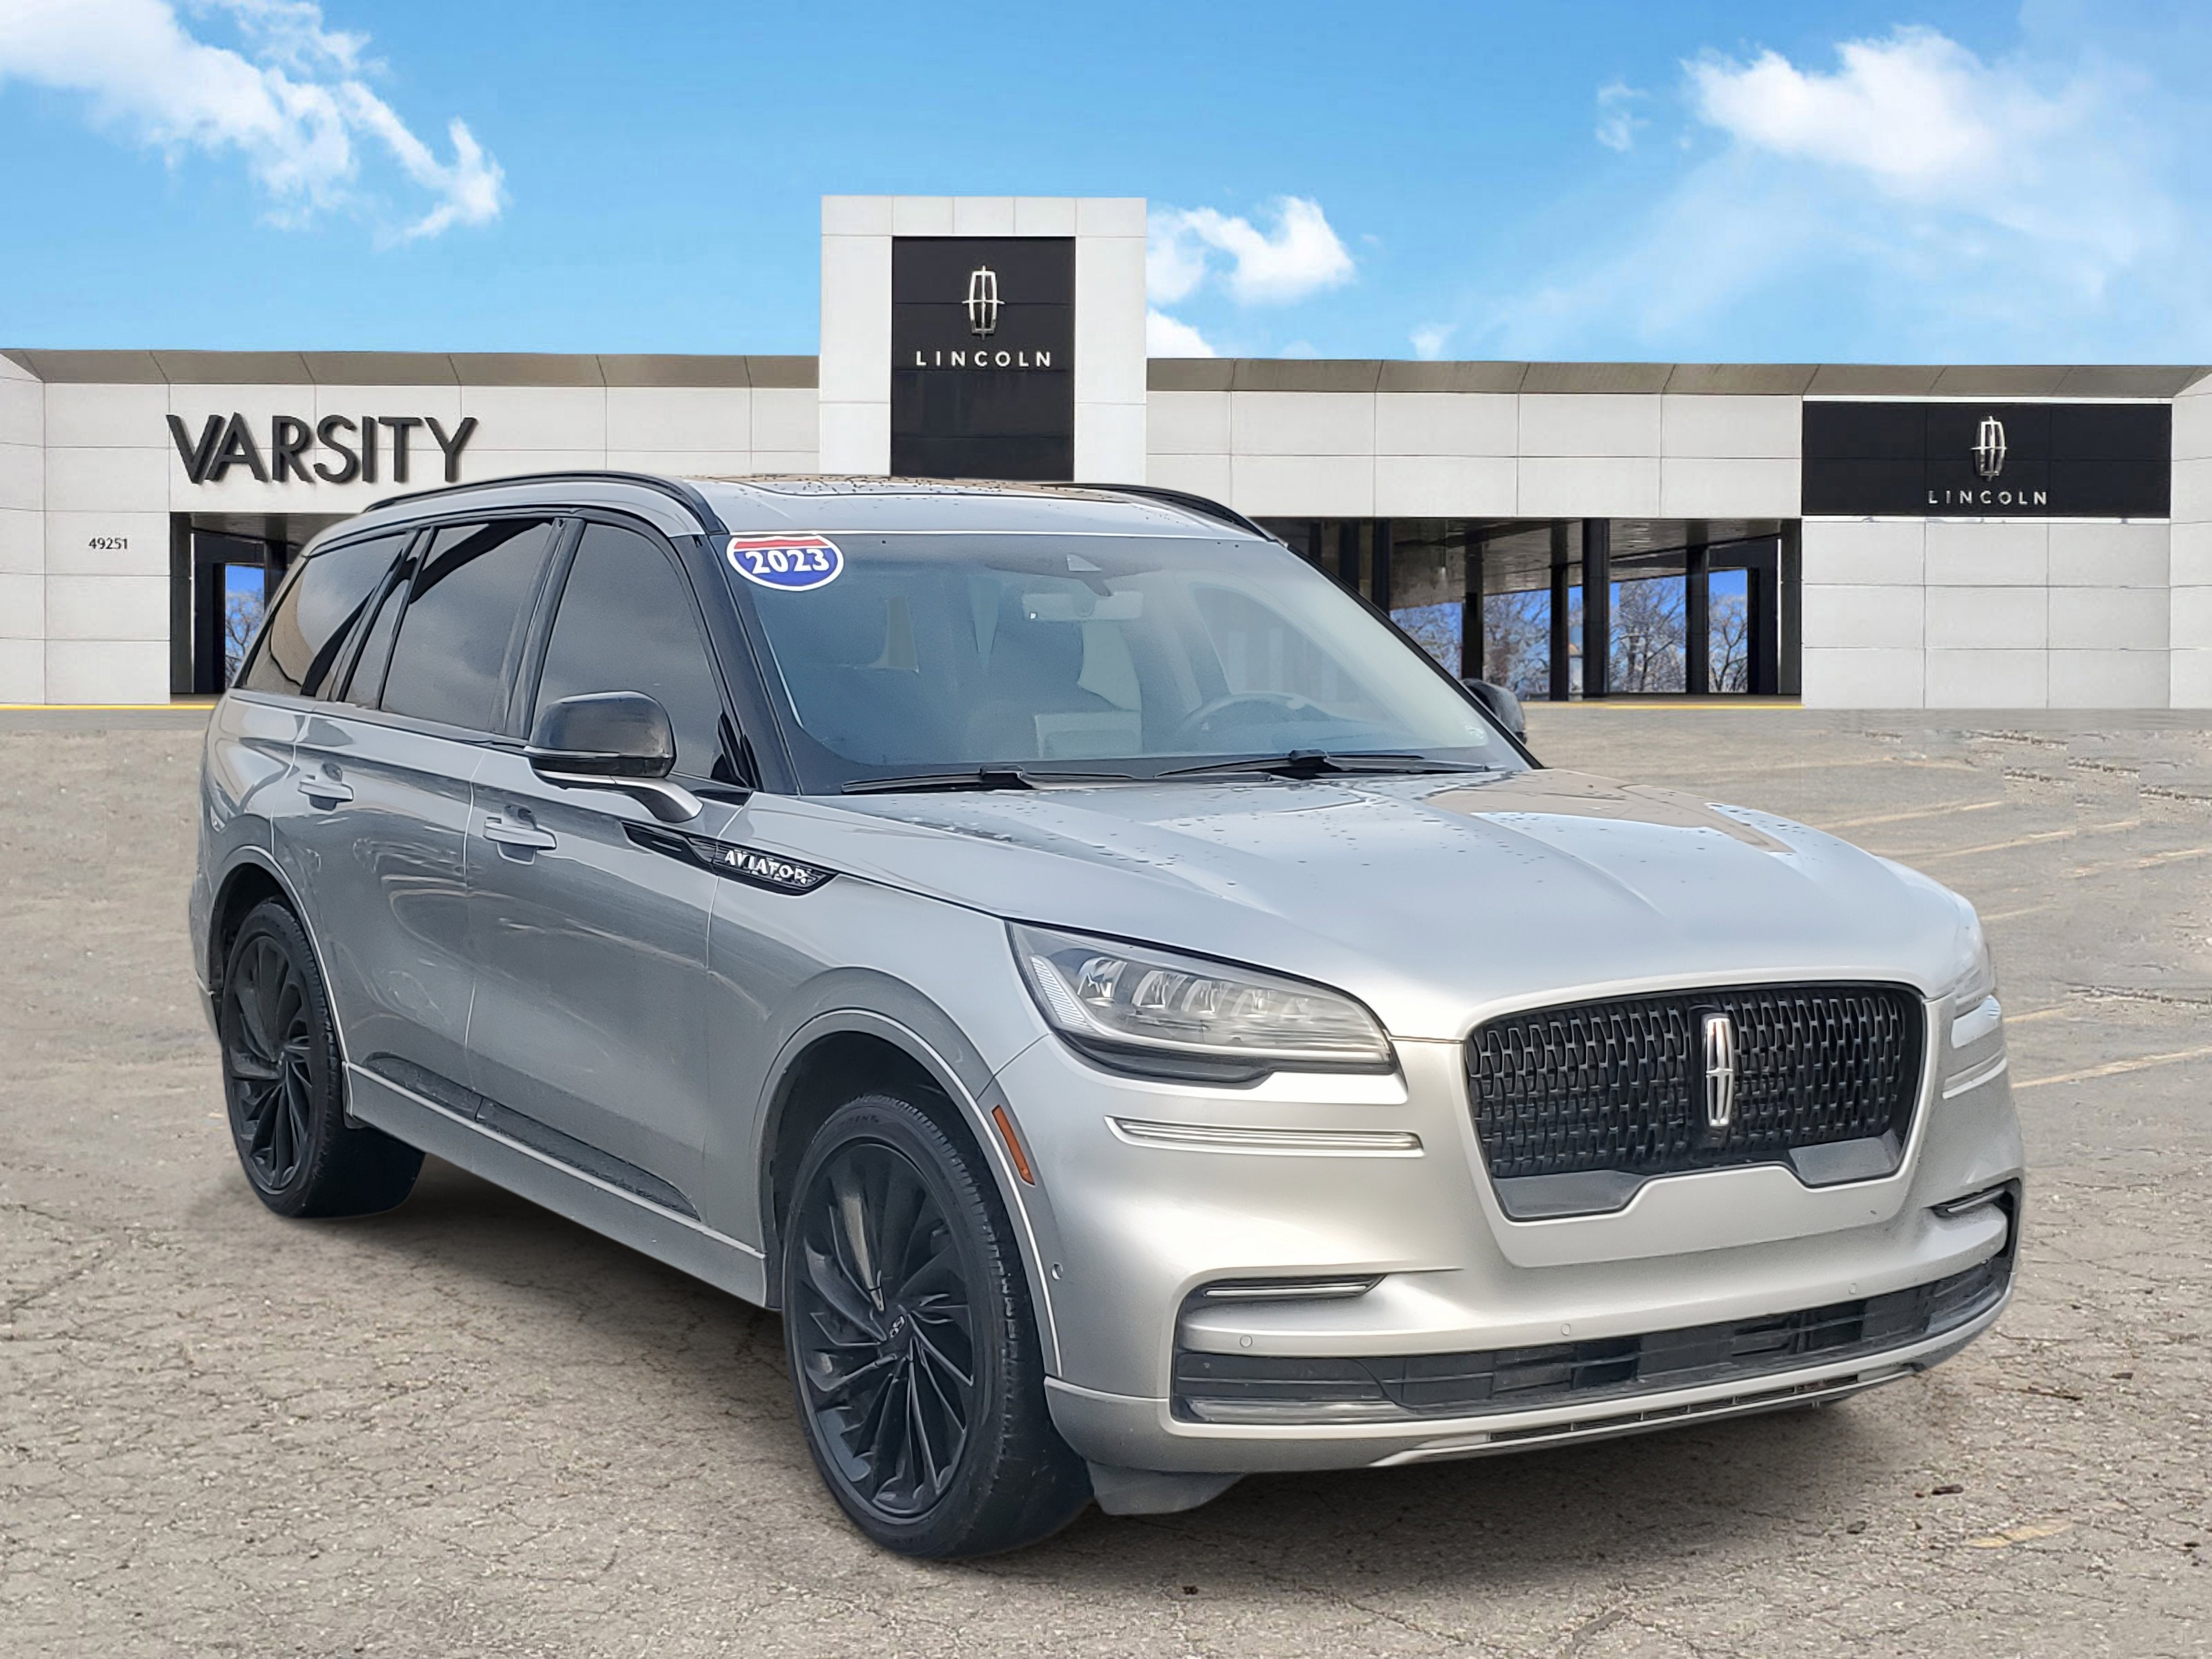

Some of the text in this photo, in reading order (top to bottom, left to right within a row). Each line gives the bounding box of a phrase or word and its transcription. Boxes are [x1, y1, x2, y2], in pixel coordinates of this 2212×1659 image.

[916, 350, 1051, 367] LINCOLN
[166, 412, 478, 484] VARSITY
[1928, 490, 2047, 505] LINCOLN
[88, 537, 129, 550] 49251
[745, 548, 829, 574] 2023
[724, 849, 812, 885] AVIATOR
